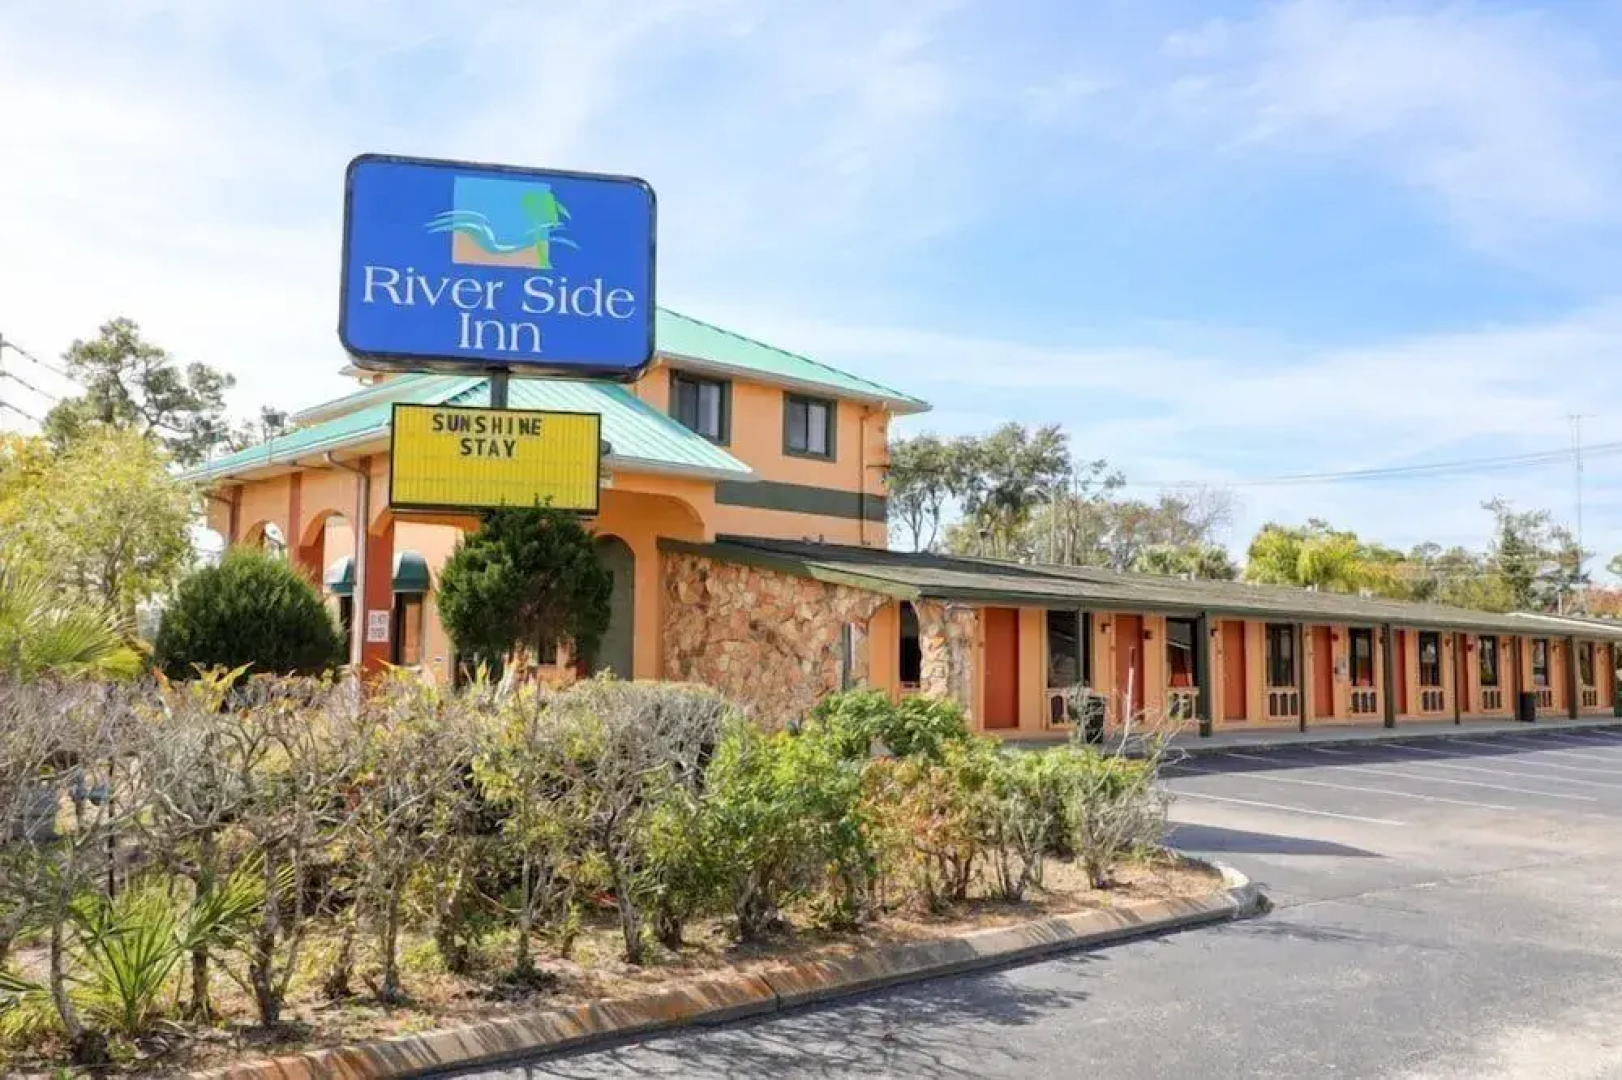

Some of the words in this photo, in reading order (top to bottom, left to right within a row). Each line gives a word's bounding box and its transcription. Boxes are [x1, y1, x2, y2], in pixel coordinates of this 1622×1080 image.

[362, 265, 503, 311] River
[521, 276, 636, 319] Side
[459, 312, 542, 352] Inn
[432, 413, 543, 436] SUNSHINE
[460, 438, 516, 457] STAY
